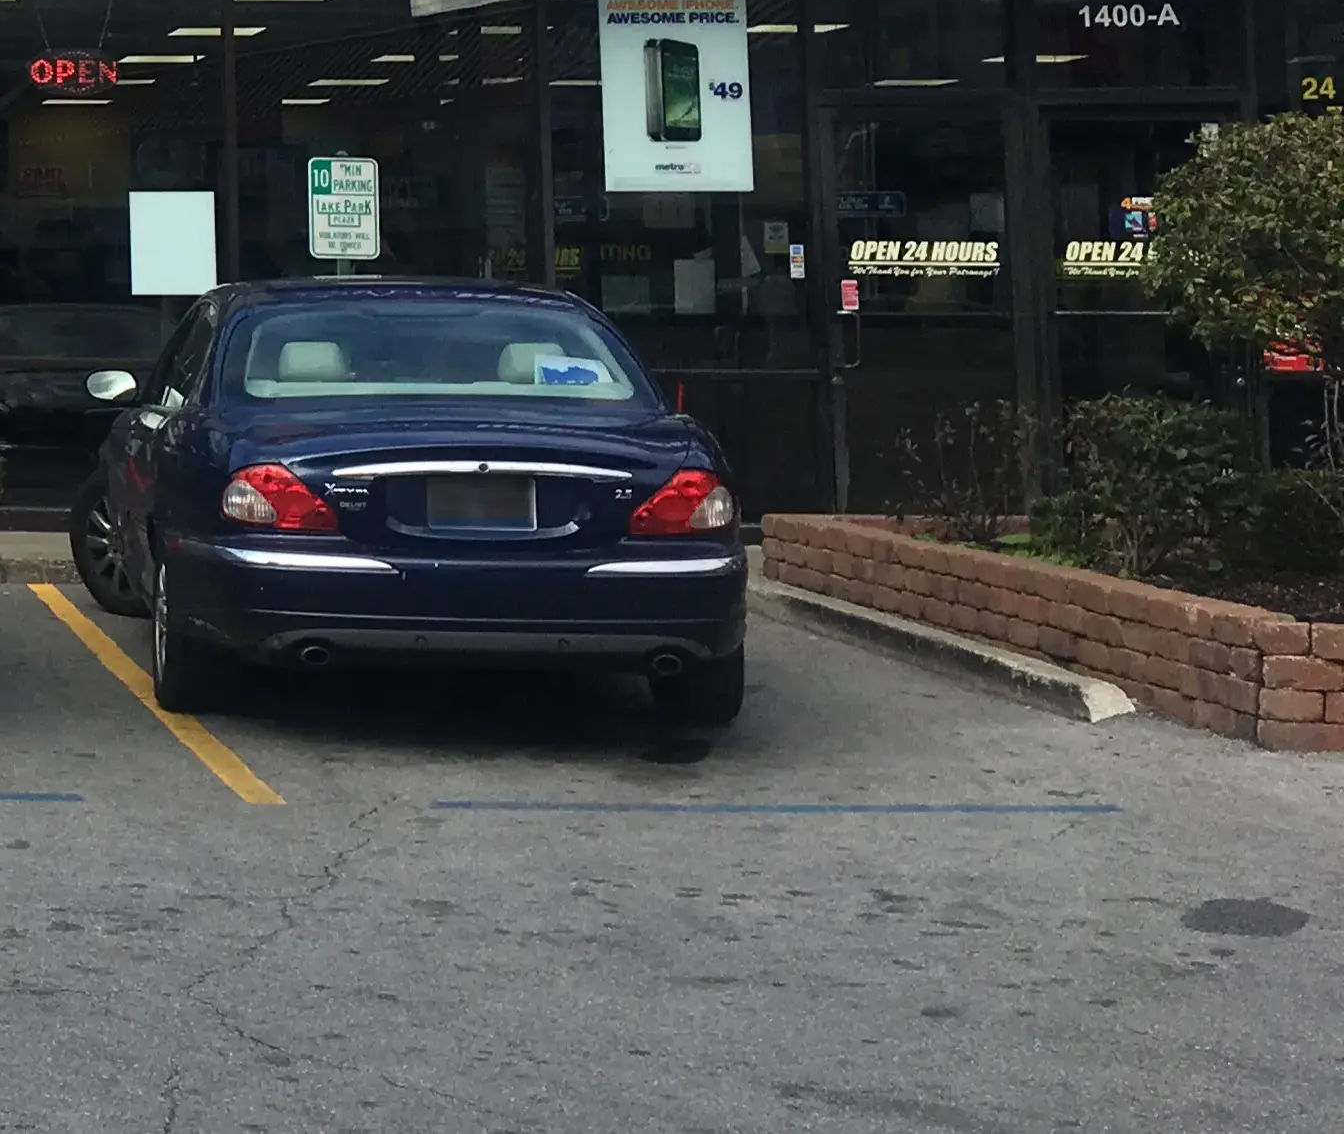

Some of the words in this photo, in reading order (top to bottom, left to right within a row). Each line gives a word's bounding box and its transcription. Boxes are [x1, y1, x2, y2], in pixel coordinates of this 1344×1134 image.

[607, 0, 678, 10] AWESOME
[607, 12, 685, 24] AWESOME
[689, 12, 740, 24] PRICE.
[1079, 3, 1180, 27] 1400-A
[30, 59, 119, 85] OPEN
[1301, 76, 1336, 100] 24
[313, 169, 329, 188] 10
[344, 165, 362, 177] MIN
[333, 179, 372, 192] PARKING
[344, 199, 371, 214] PARK
[850, 240, 901, 261] OPEN
[902, 240, 929, 261] 24
[931, 240, 999, 262] HOURS
[1065, 241, 1117, 262] OPEN
[1117, 241, 1144, 262] 24
